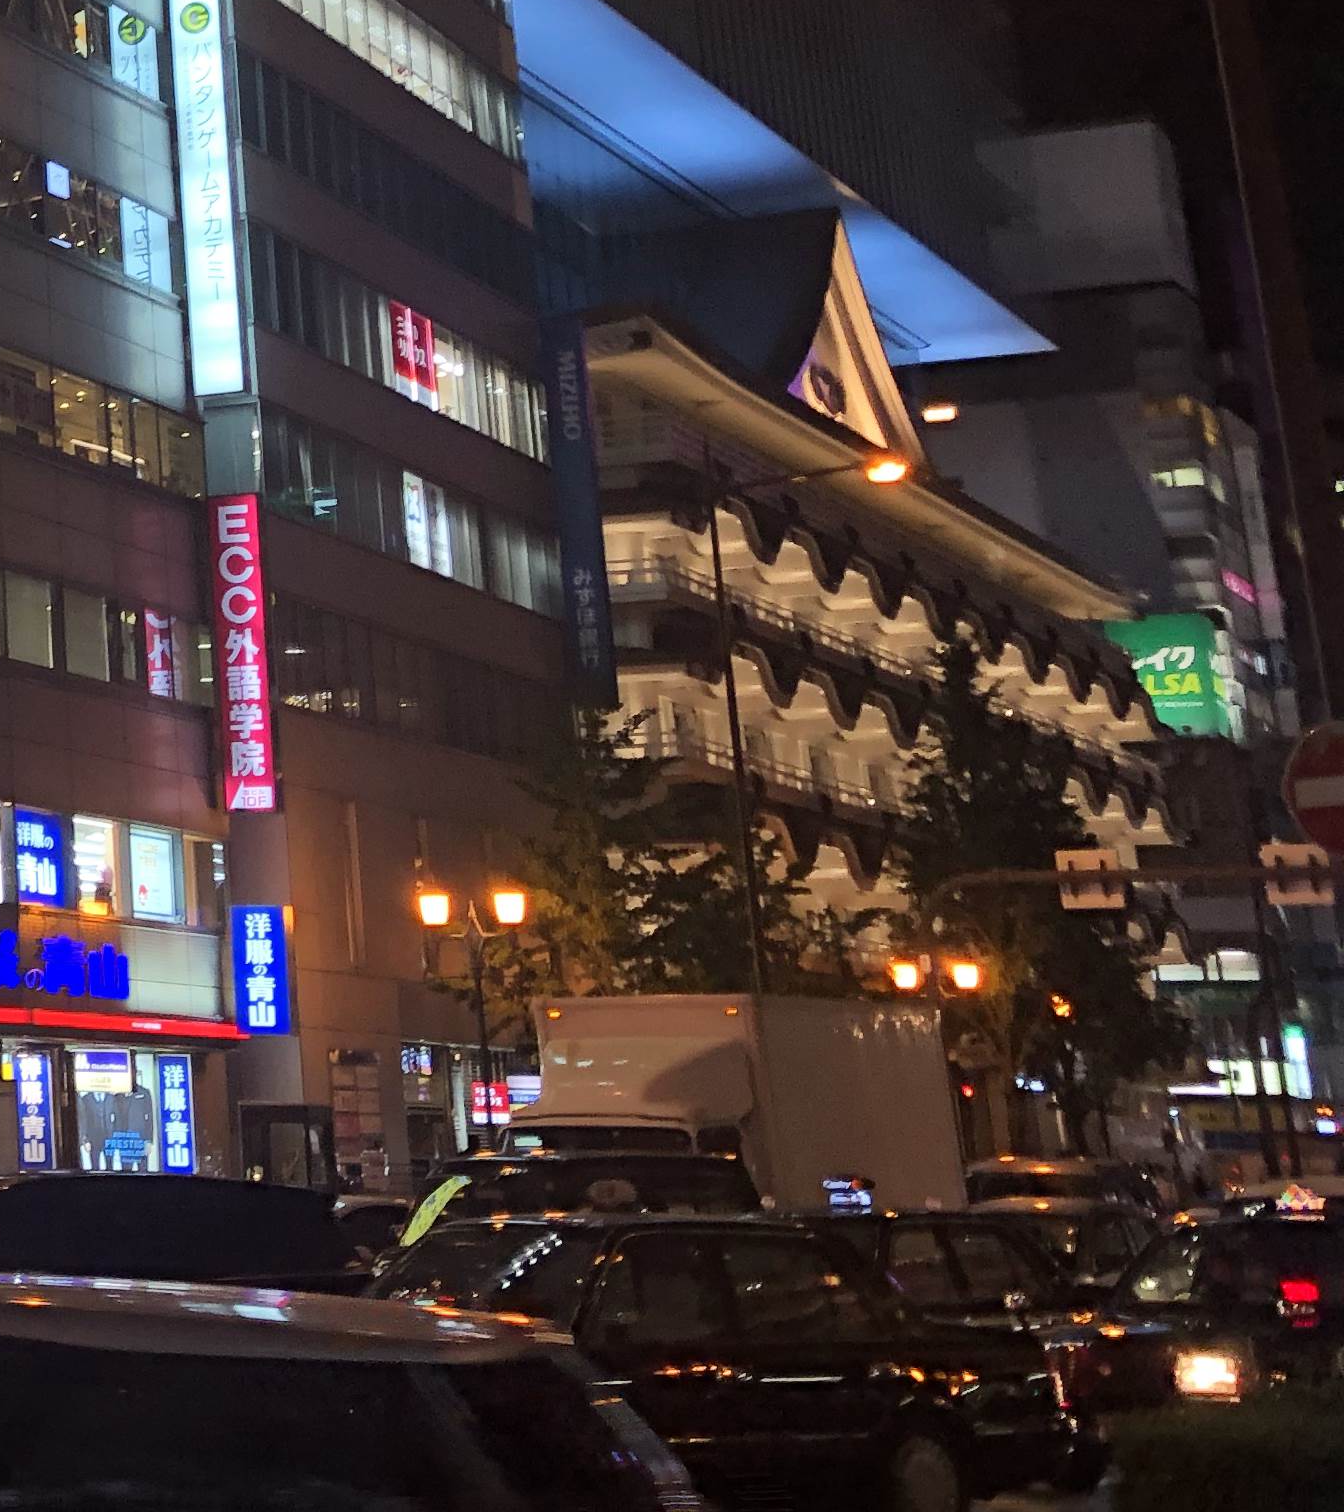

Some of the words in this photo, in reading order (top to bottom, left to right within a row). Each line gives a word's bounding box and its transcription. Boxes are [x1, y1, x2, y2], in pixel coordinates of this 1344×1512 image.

[557, 348, 581, 442] MIZUHO
[217, 503, 266, 778] ECC外語学院
[1131, 645, 1196, 672] イク
[1144, 671, 1202, 697] LSA
[16, 820, 55, 850] 洋服の
[18, 852, 57, 896] 青山
[243, 910, 277, 1029] 洋服の青山
[17, 1056, 47, 1164] 洋服の青山
[162, 1064, 191, 1169] 洋服の青山
